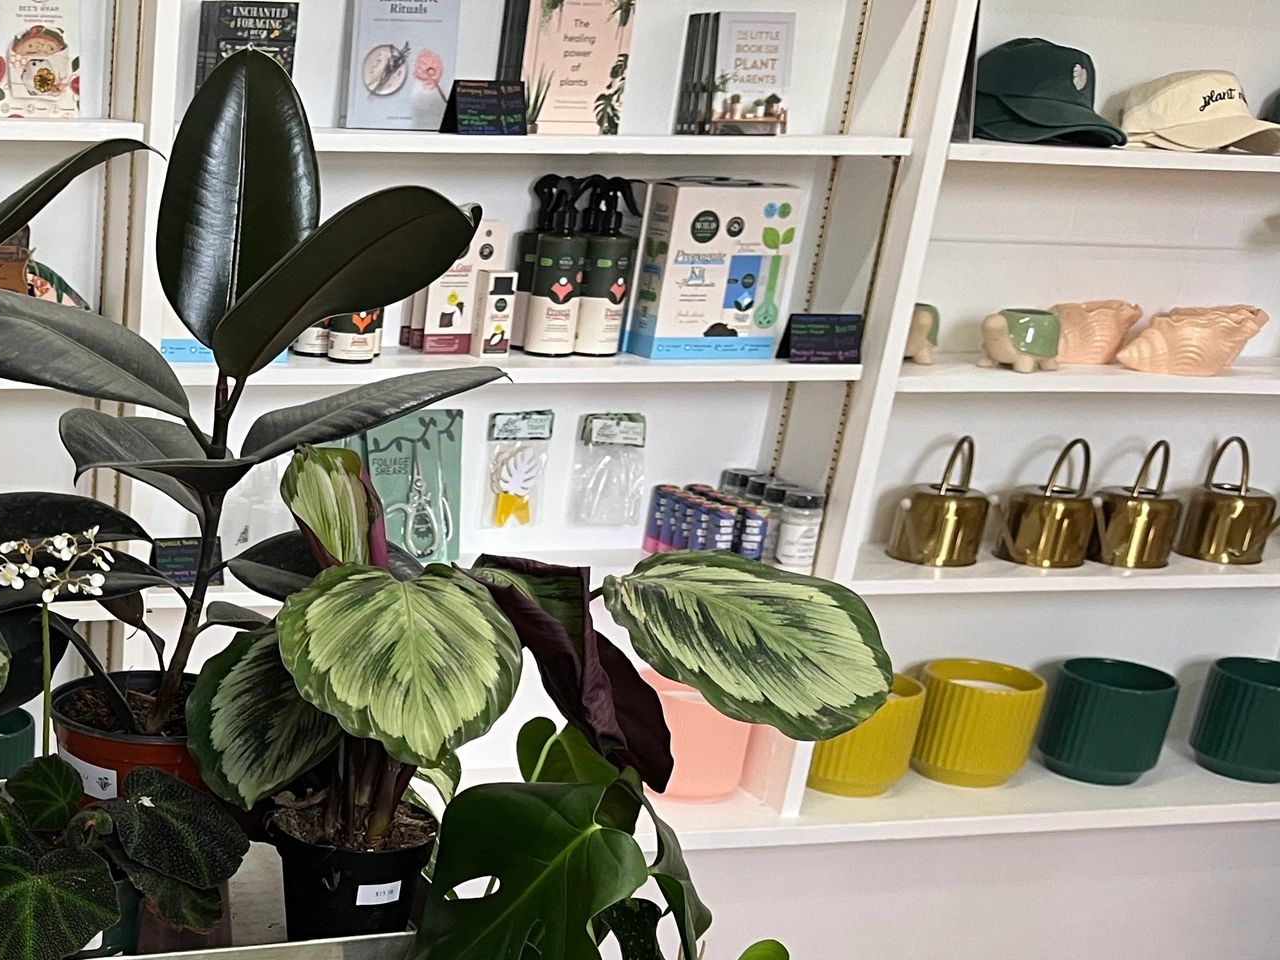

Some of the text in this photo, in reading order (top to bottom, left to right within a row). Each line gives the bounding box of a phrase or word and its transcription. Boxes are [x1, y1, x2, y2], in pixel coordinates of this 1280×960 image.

[232, 6, 289, 18] ENCHANTED
[390, 3, 428, 14] Rituals
[236, 17, 283, 30] FORAGING
[573, 18, 590, 28] The
[563, 33, 597, 45] healing
[749, 30, 780, 41] LITTLE
[563, 50, 592, 58] power
[570, 62, 582, 72] of
[734, 57, 778, 70] PLANT
[560, 77, 588, 87] plants
[732, 74, 777, 84] PARENTS
[1199, 87, 1236, 112] plant
[371, 456, 410, 467] FOLIAGE
[374, 466, 408, 476] SHEARS
